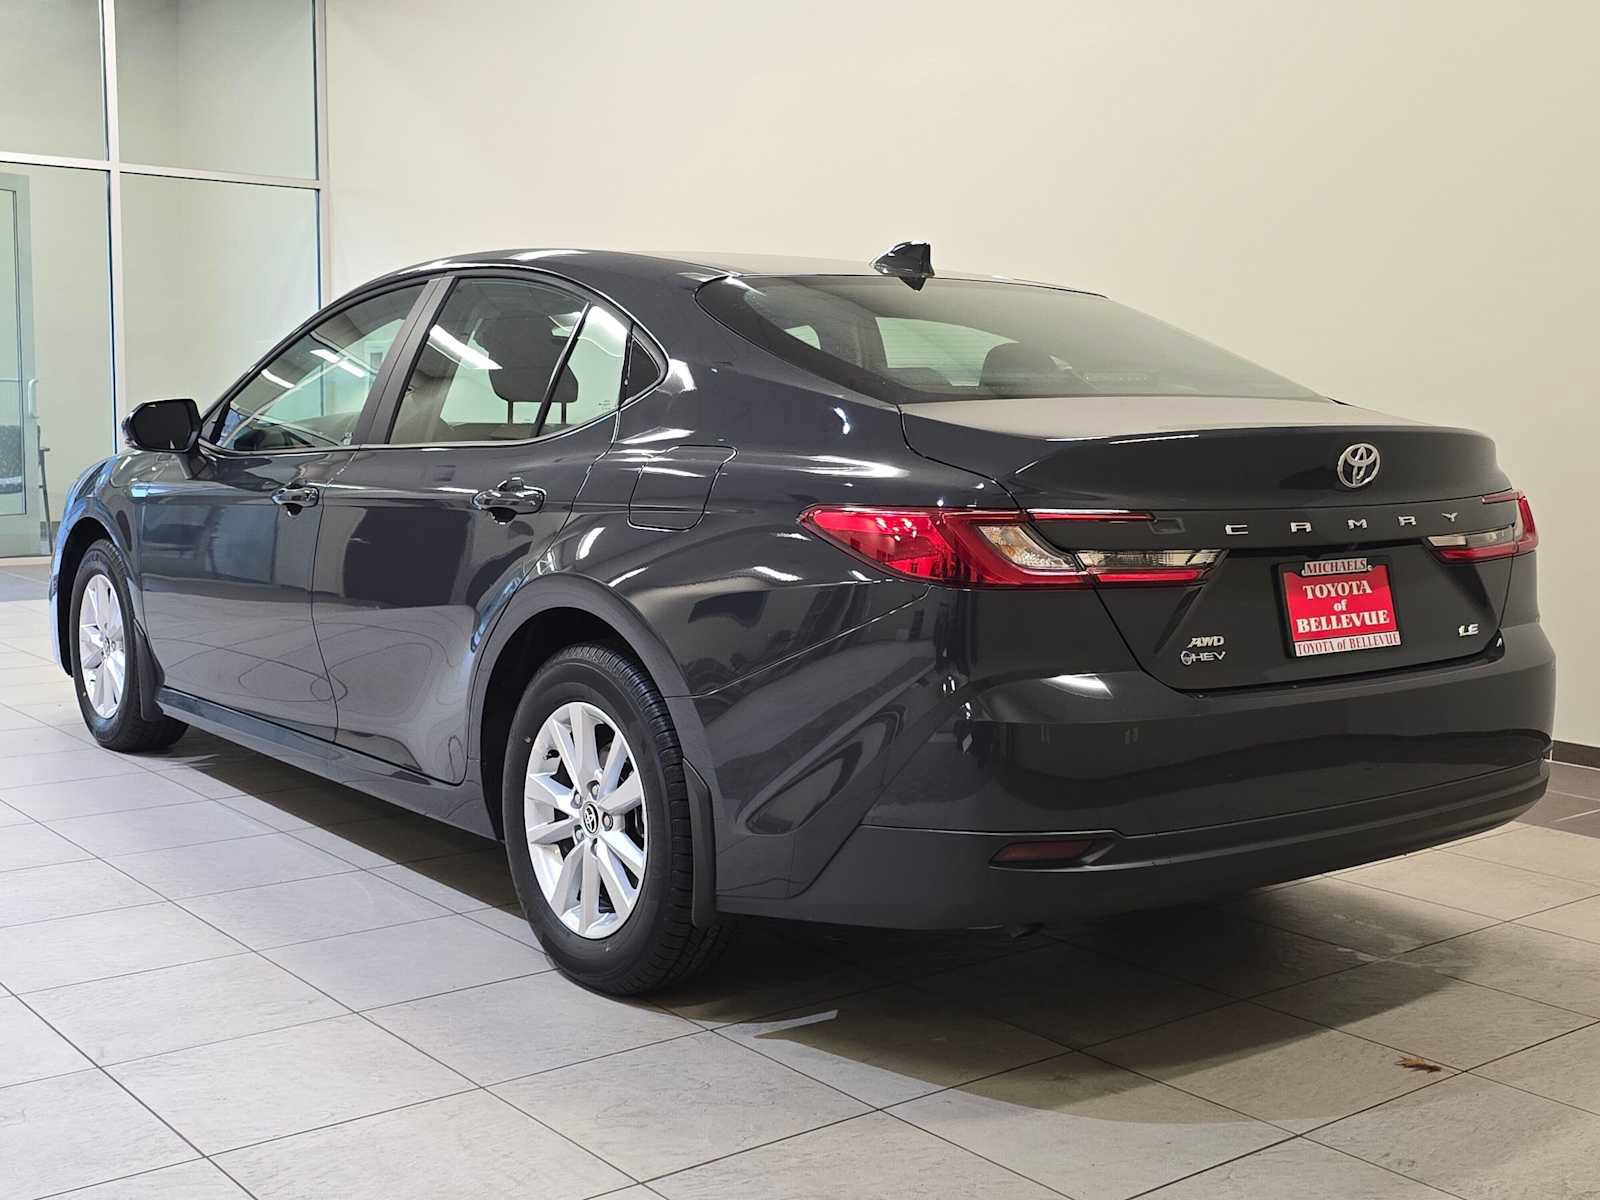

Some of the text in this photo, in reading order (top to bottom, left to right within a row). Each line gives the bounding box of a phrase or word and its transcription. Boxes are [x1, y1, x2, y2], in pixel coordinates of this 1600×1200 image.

[1225, 512, 1458, 535] CAMRY
[1303, 580, 1372, 600] TOYOTA
[1333, 599, 1348, 612] of
[1296, 610, 1390, 633] BELLEVUE
[1459, 623, 1479, 637] LE
[1187, 636, 1224, 648] AWD
[1297, 633, 1399, 655] TOYOTA of BELLEVUE
